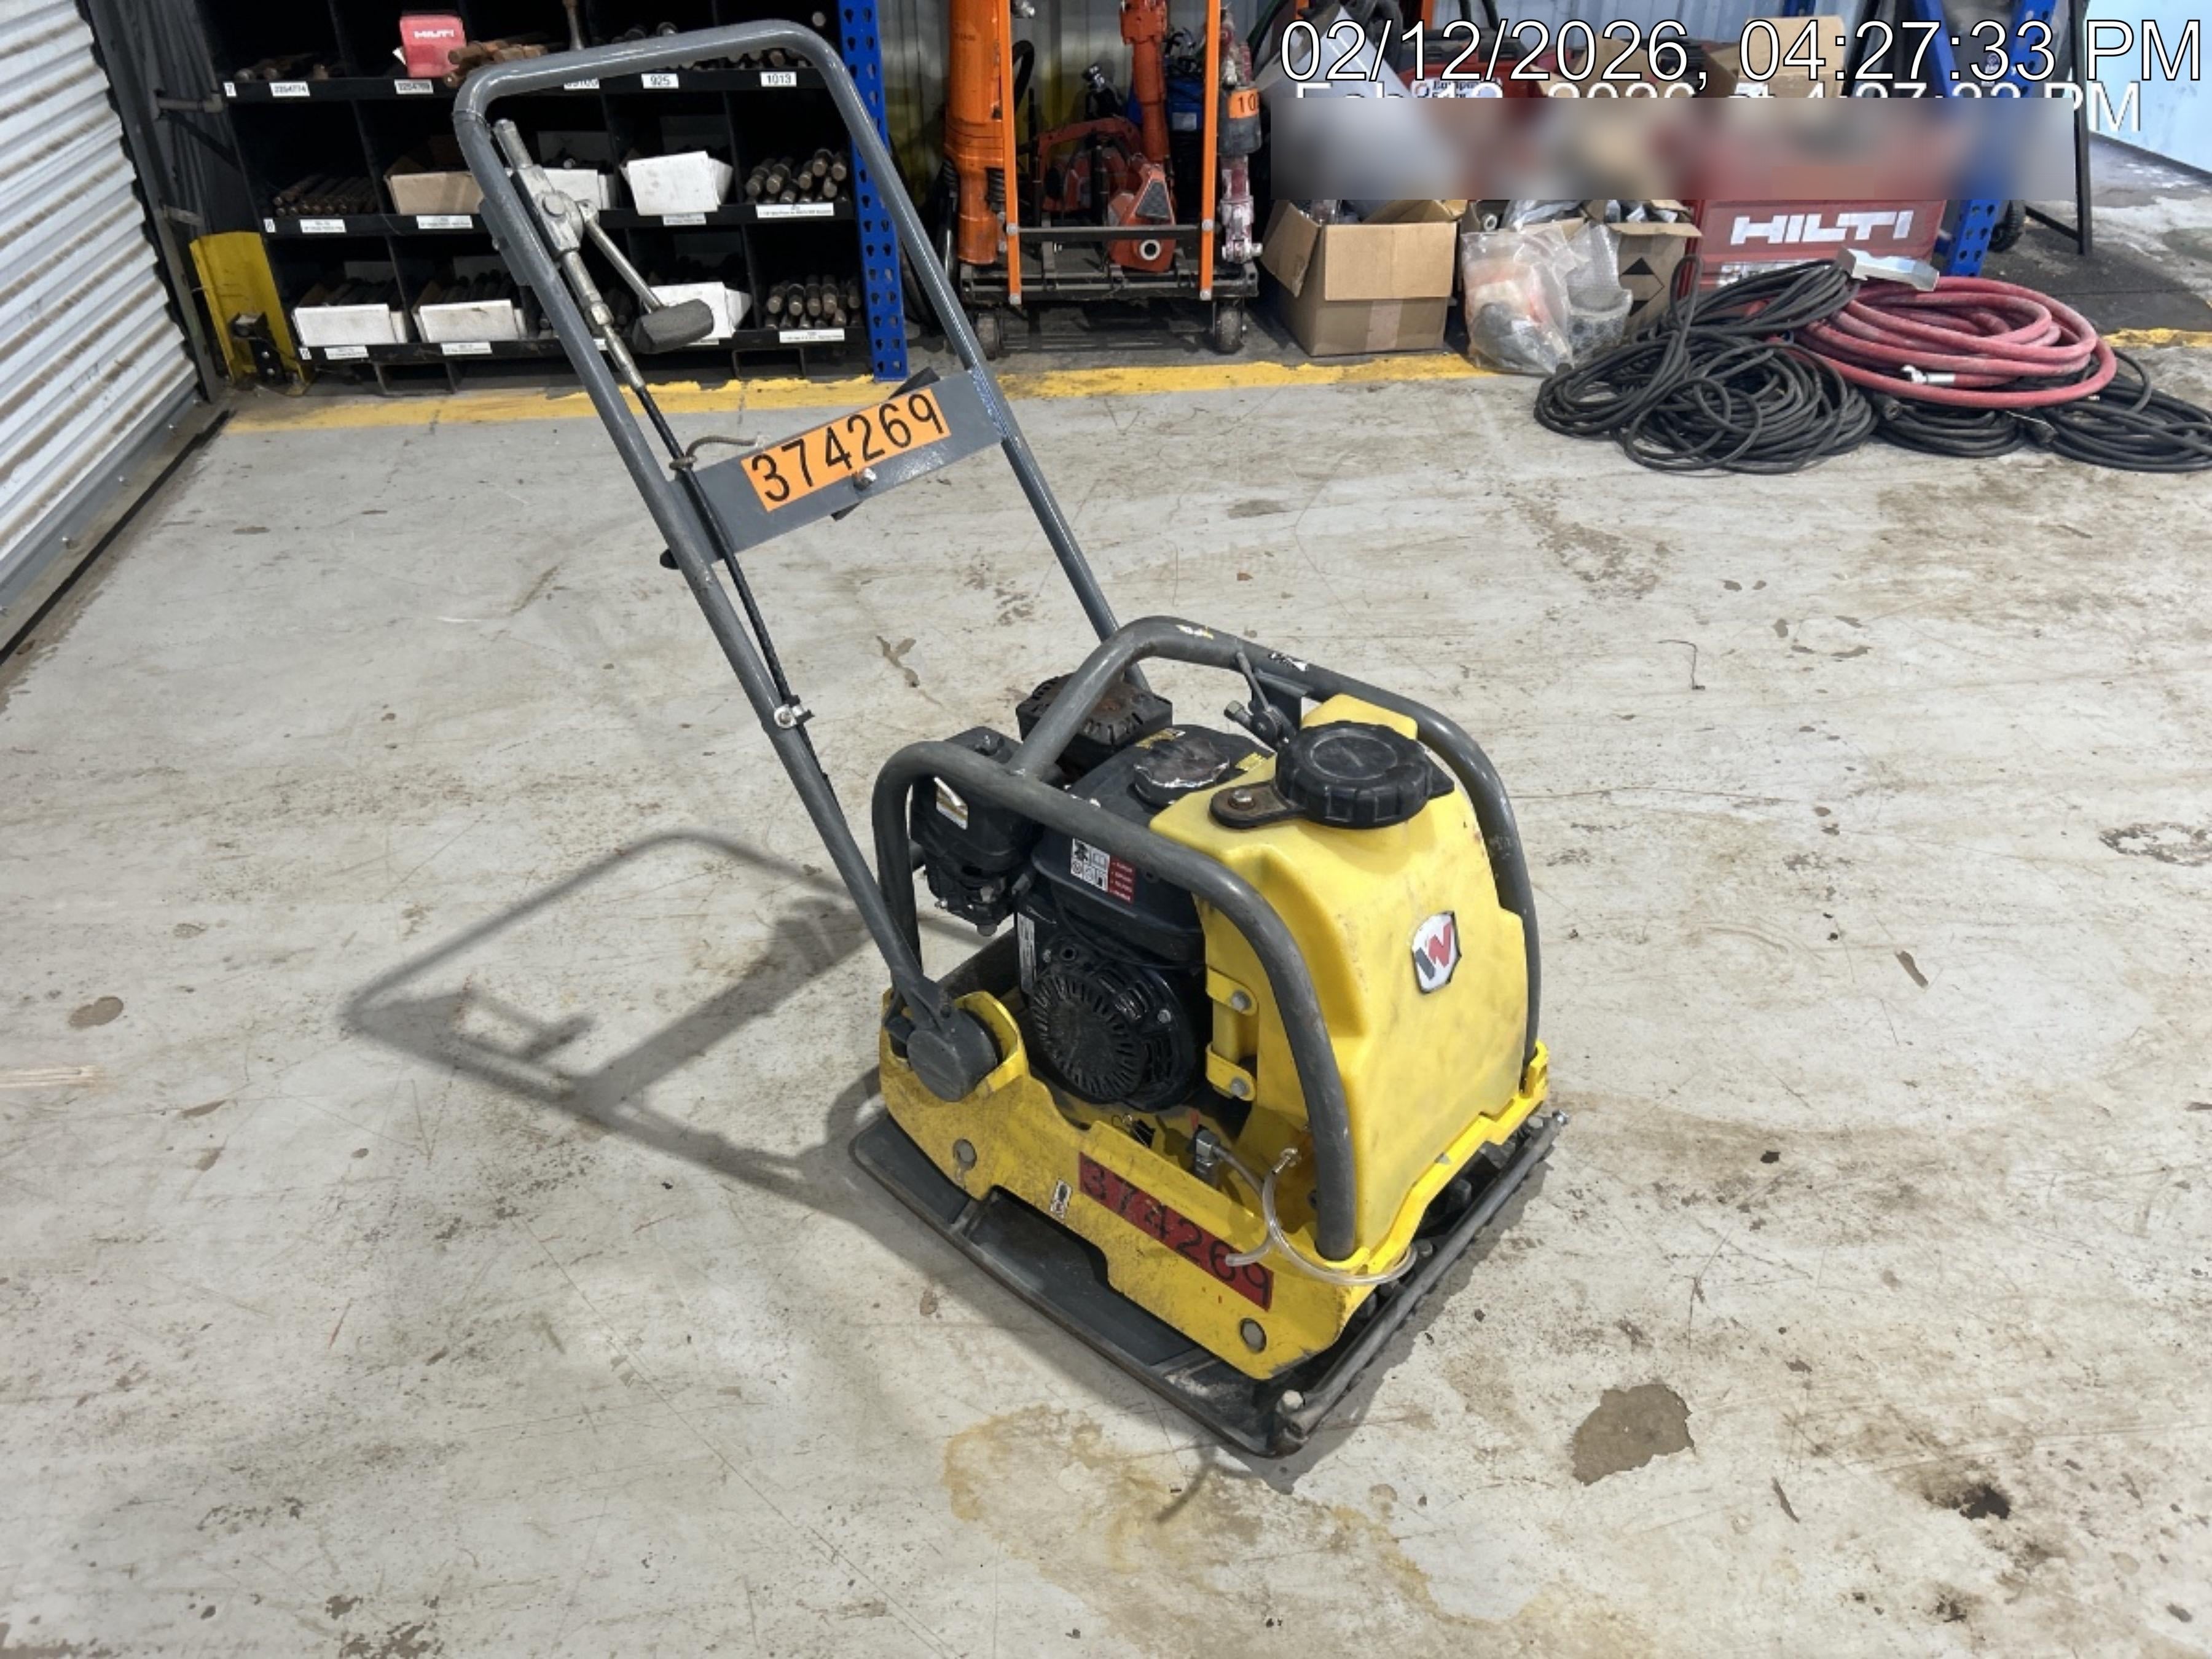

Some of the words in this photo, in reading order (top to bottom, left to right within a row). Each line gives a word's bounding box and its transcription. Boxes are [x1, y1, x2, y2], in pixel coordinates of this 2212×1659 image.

[649, 75, 671, 85] 925
[766, 73, 792, 85] 1013
[1730, 210, 1914, 245] HILTI
[751, 393, 945, 502] 374269
[1083, 1158, 1270, 1311] 374269
